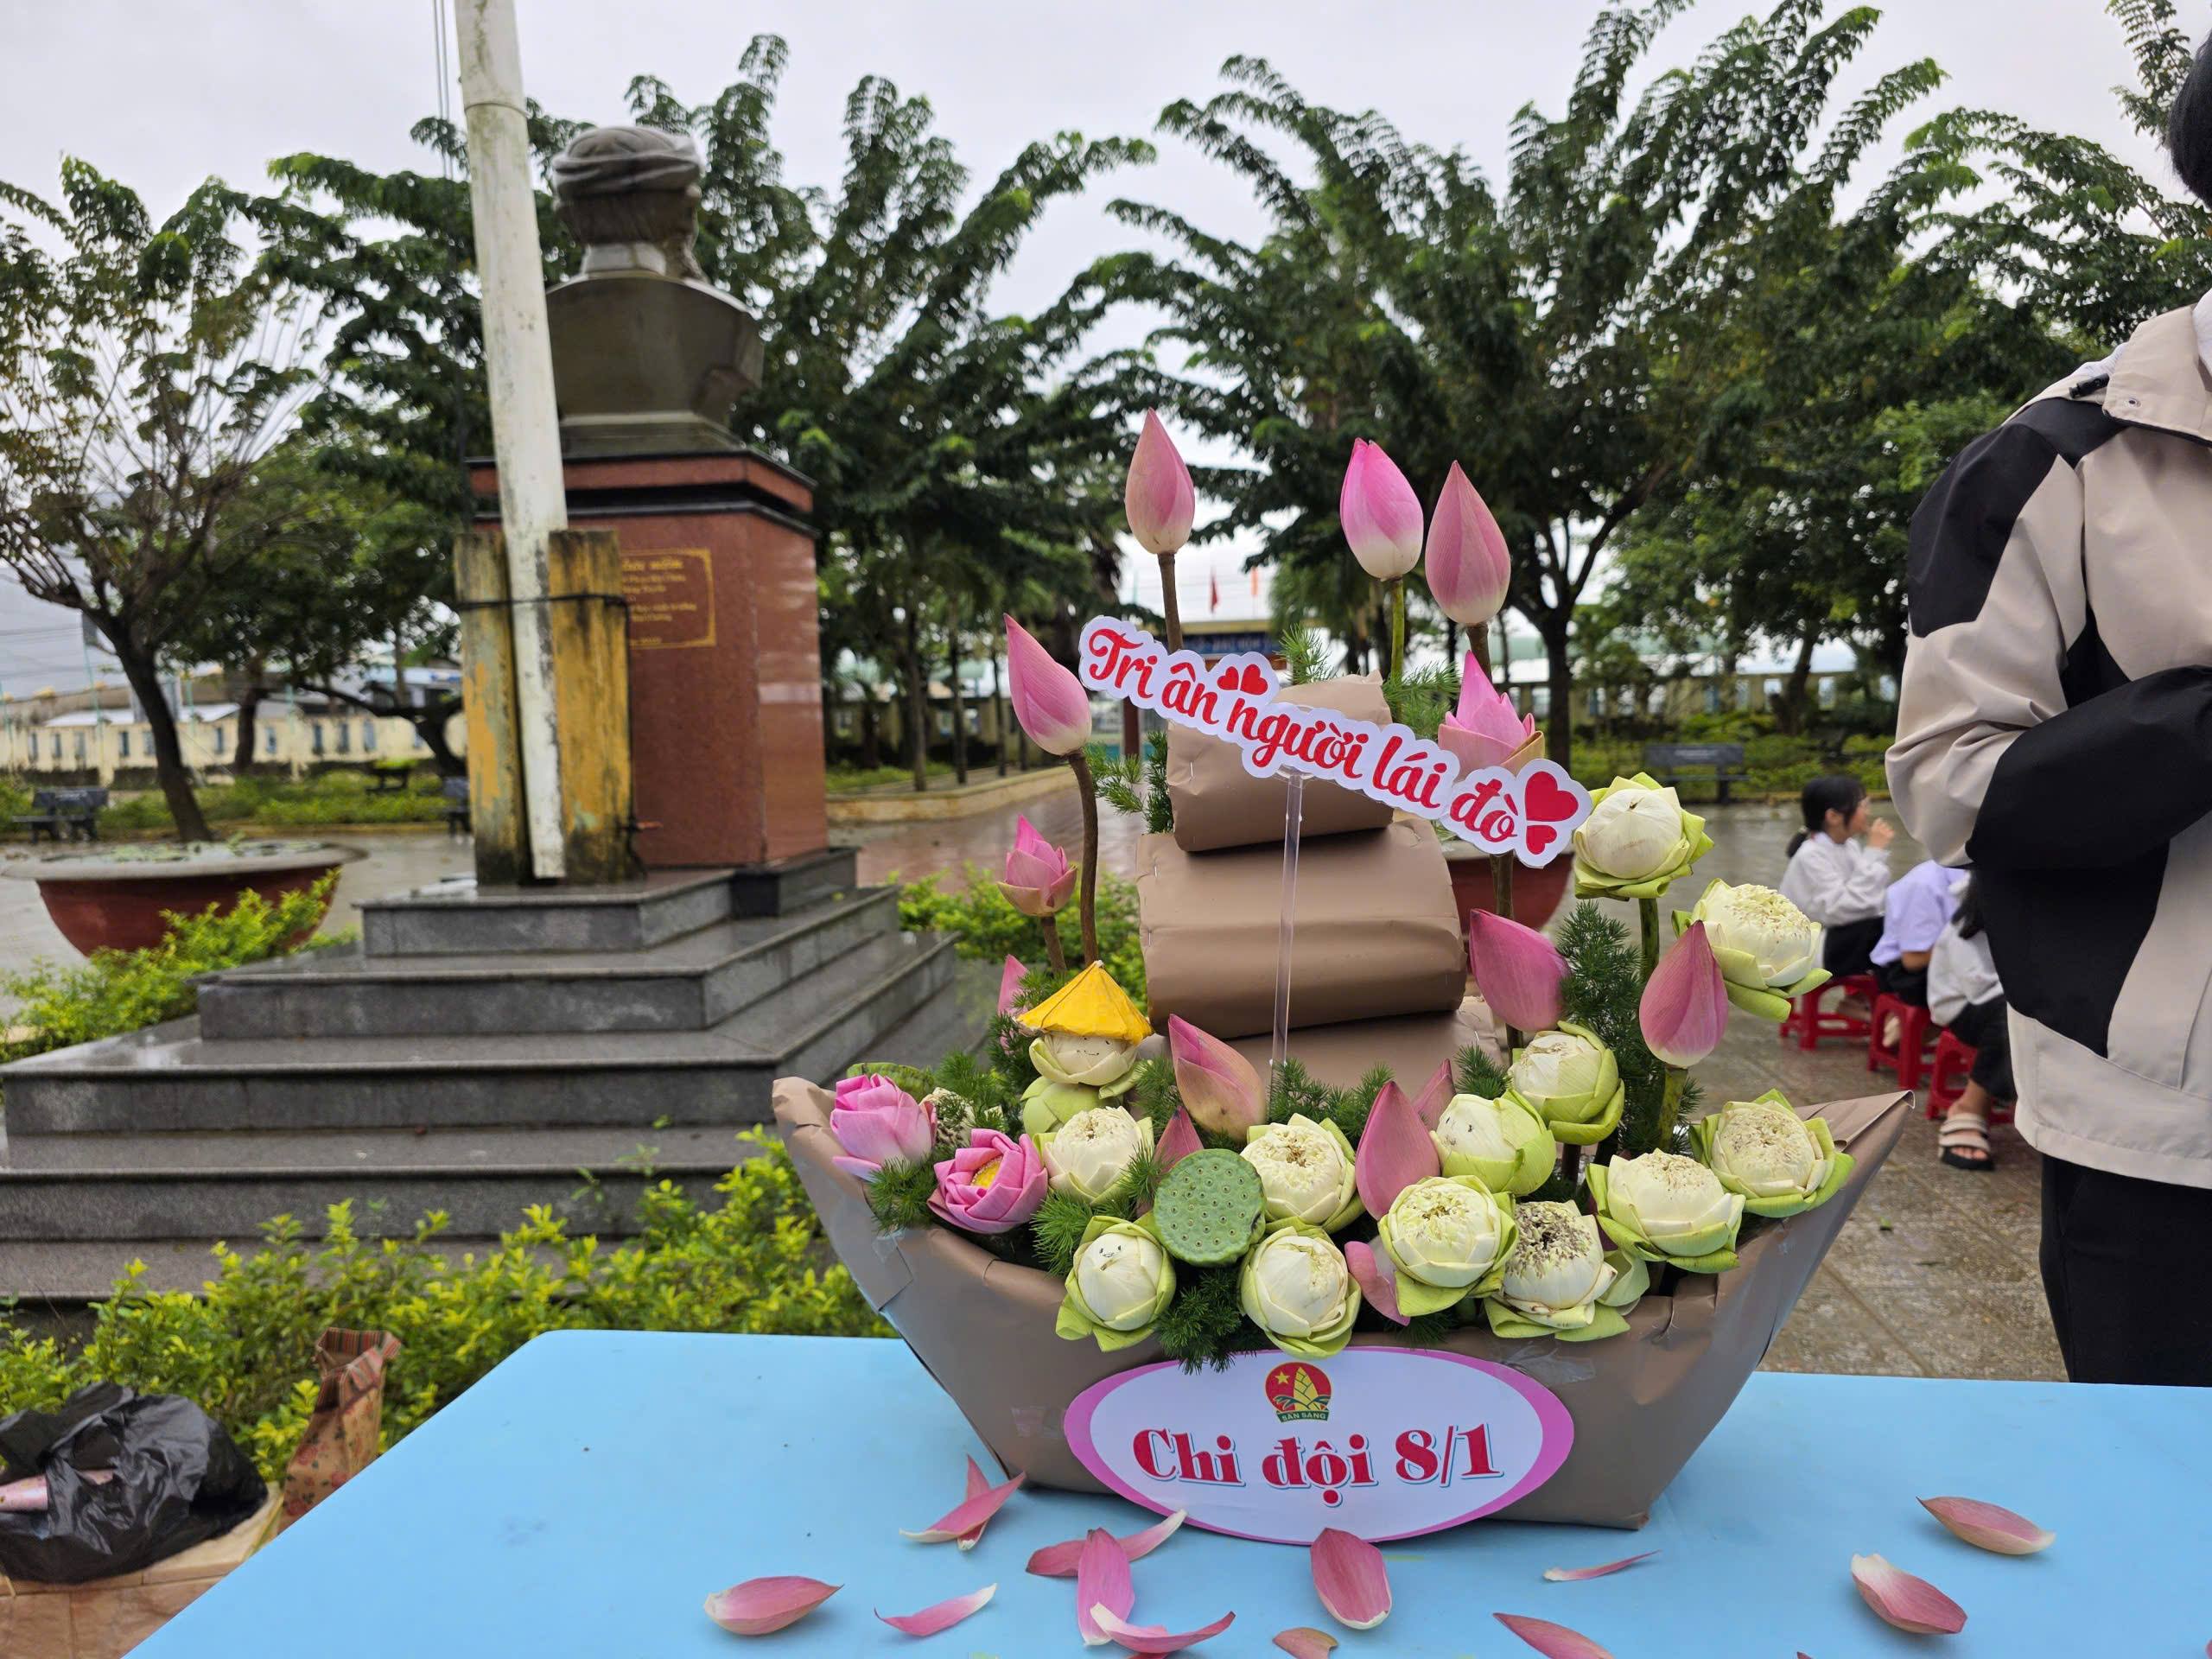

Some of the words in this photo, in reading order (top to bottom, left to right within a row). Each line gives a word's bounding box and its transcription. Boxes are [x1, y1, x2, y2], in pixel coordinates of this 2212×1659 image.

[1089, 628, 1158, 699] Tri
[1161, 661, 1219, 725] ân
[1226, 697, 1369, 779] người
[1372, 735, 1448, 809] lái
[1449, 779, 1517, 843] đò
[1132, 1428, 1244, 1486] Chi
[1262, 1434, 1376, 1506] đội
[1395, 1423, 1503, 1486] 8/1
